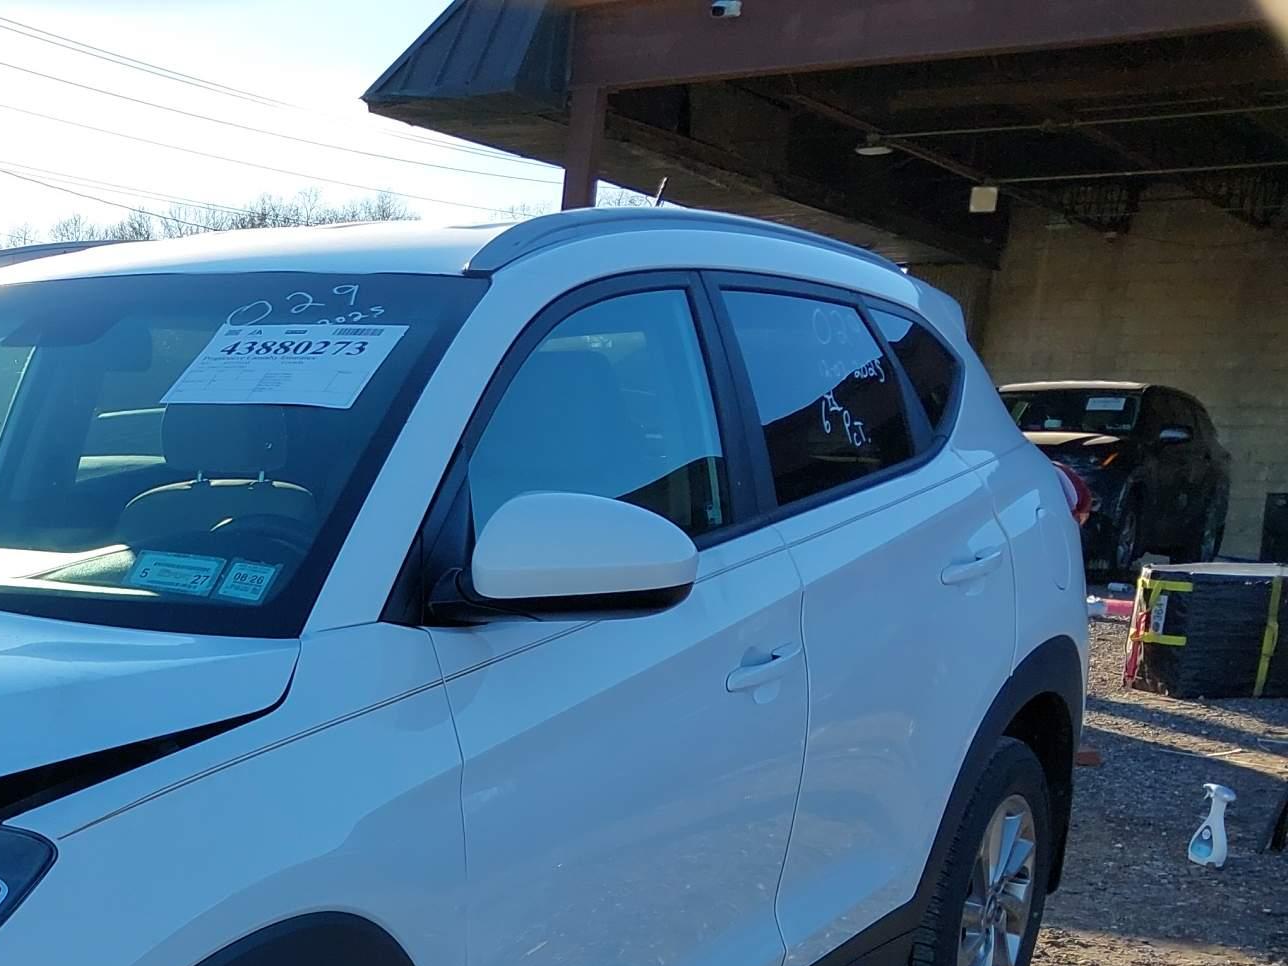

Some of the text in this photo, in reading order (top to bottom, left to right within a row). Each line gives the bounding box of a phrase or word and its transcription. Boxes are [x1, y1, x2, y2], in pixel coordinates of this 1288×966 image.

[220, 340, 368, 356] 43880273
[139, 568, 151, 578] 5
[190, 574, 210, 586] 27
